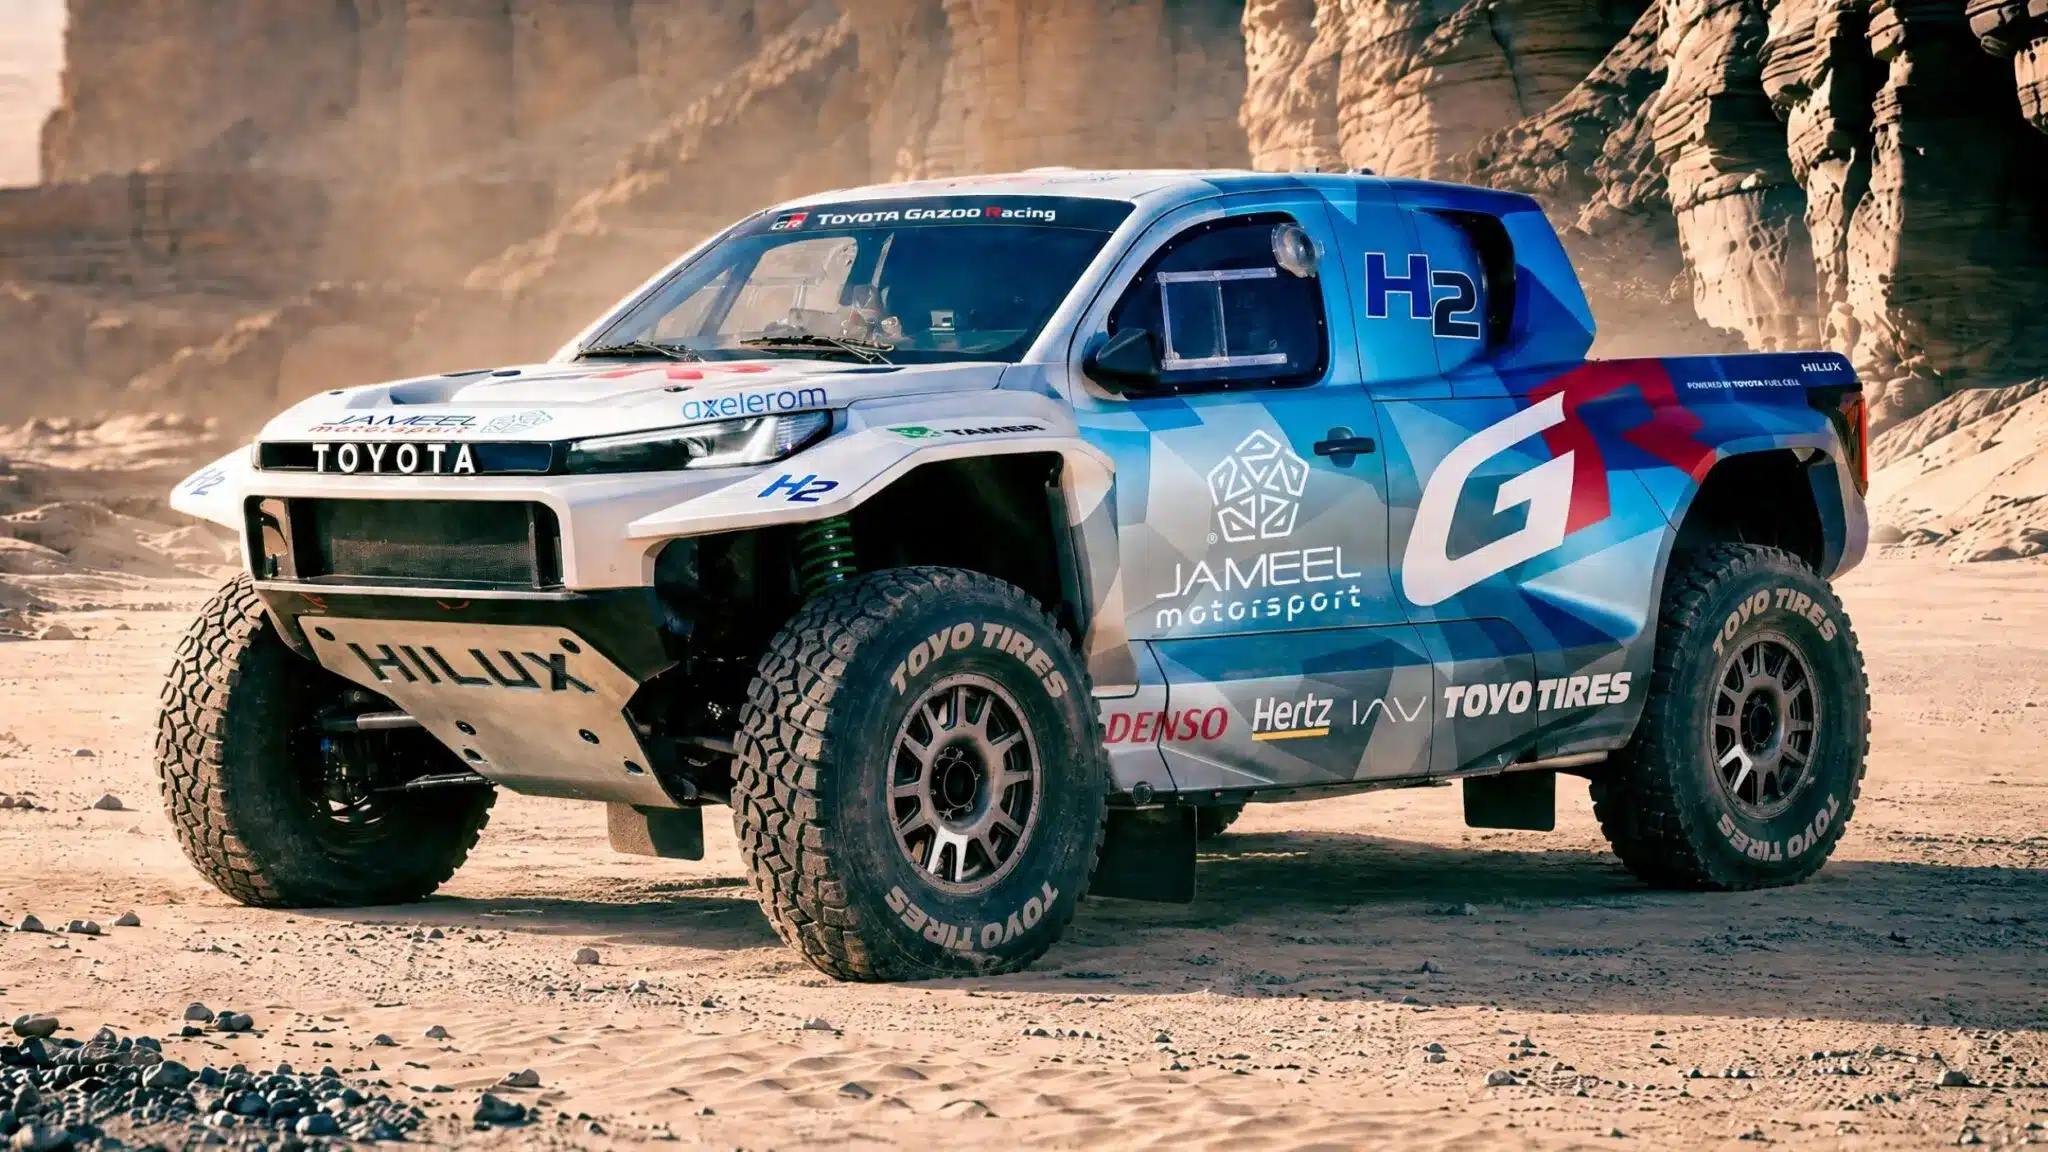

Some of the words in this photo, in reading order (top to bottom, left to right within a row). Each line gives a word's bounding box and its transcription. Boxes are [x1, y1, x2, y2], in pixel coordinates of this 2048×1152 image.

[818, 211, 900, 226] TOYOTA
[905, 207, 981, 220] GAZOO
[985, 206, 1056, 222] Racing
[1364, 252, 1481, 340] H2
[1687, 380, 1721, 390] POWERED
[1722, 380, 1731, 389] BY
[1732, 380, 1763, 388] TOYOTA
[1764, 379, 1782, 387] FUEL
[1783, 378, 1801, 386] CELL
[1801, 362, 1842, 373] HILUX
[323, 415, 476, 426] JAMEEL
[682, 387, 827, 421] axelerom
[308, 425, 471, 434] motorsport
[944, 424, 1046, 436] TAMER
[312, 443, 477, 474] TOYOTA
[757, 473, 840, 502] H2
[1156, 546, 1361, 599] JAMEEL
[1156, 584, 1361, 629] motorsport
[1713, 588, 1770, 657] TOYO
[1774, 587, 1838, 642] TIRES
[346, 642, 596, 693] HILUX
[890, 622, 975, 696] TOYO
[982, 622, 1069, 698] TIRES
[1252, 692, 1334, 732] Hertz
[1352, 696, 1427, 726] IAV
[1444, 682, 1536, 718] TOYO
[1537, 671, 1632, 710] TIRES
[1104, 707, 1228, 744] DENSO
[1717, 812, 1783, 862] TIRES
[1787, 793, 1841, 857] TOYO
[884, 885, 975, 951] TIRES
[981, 881, 1060, 949] TOYO
